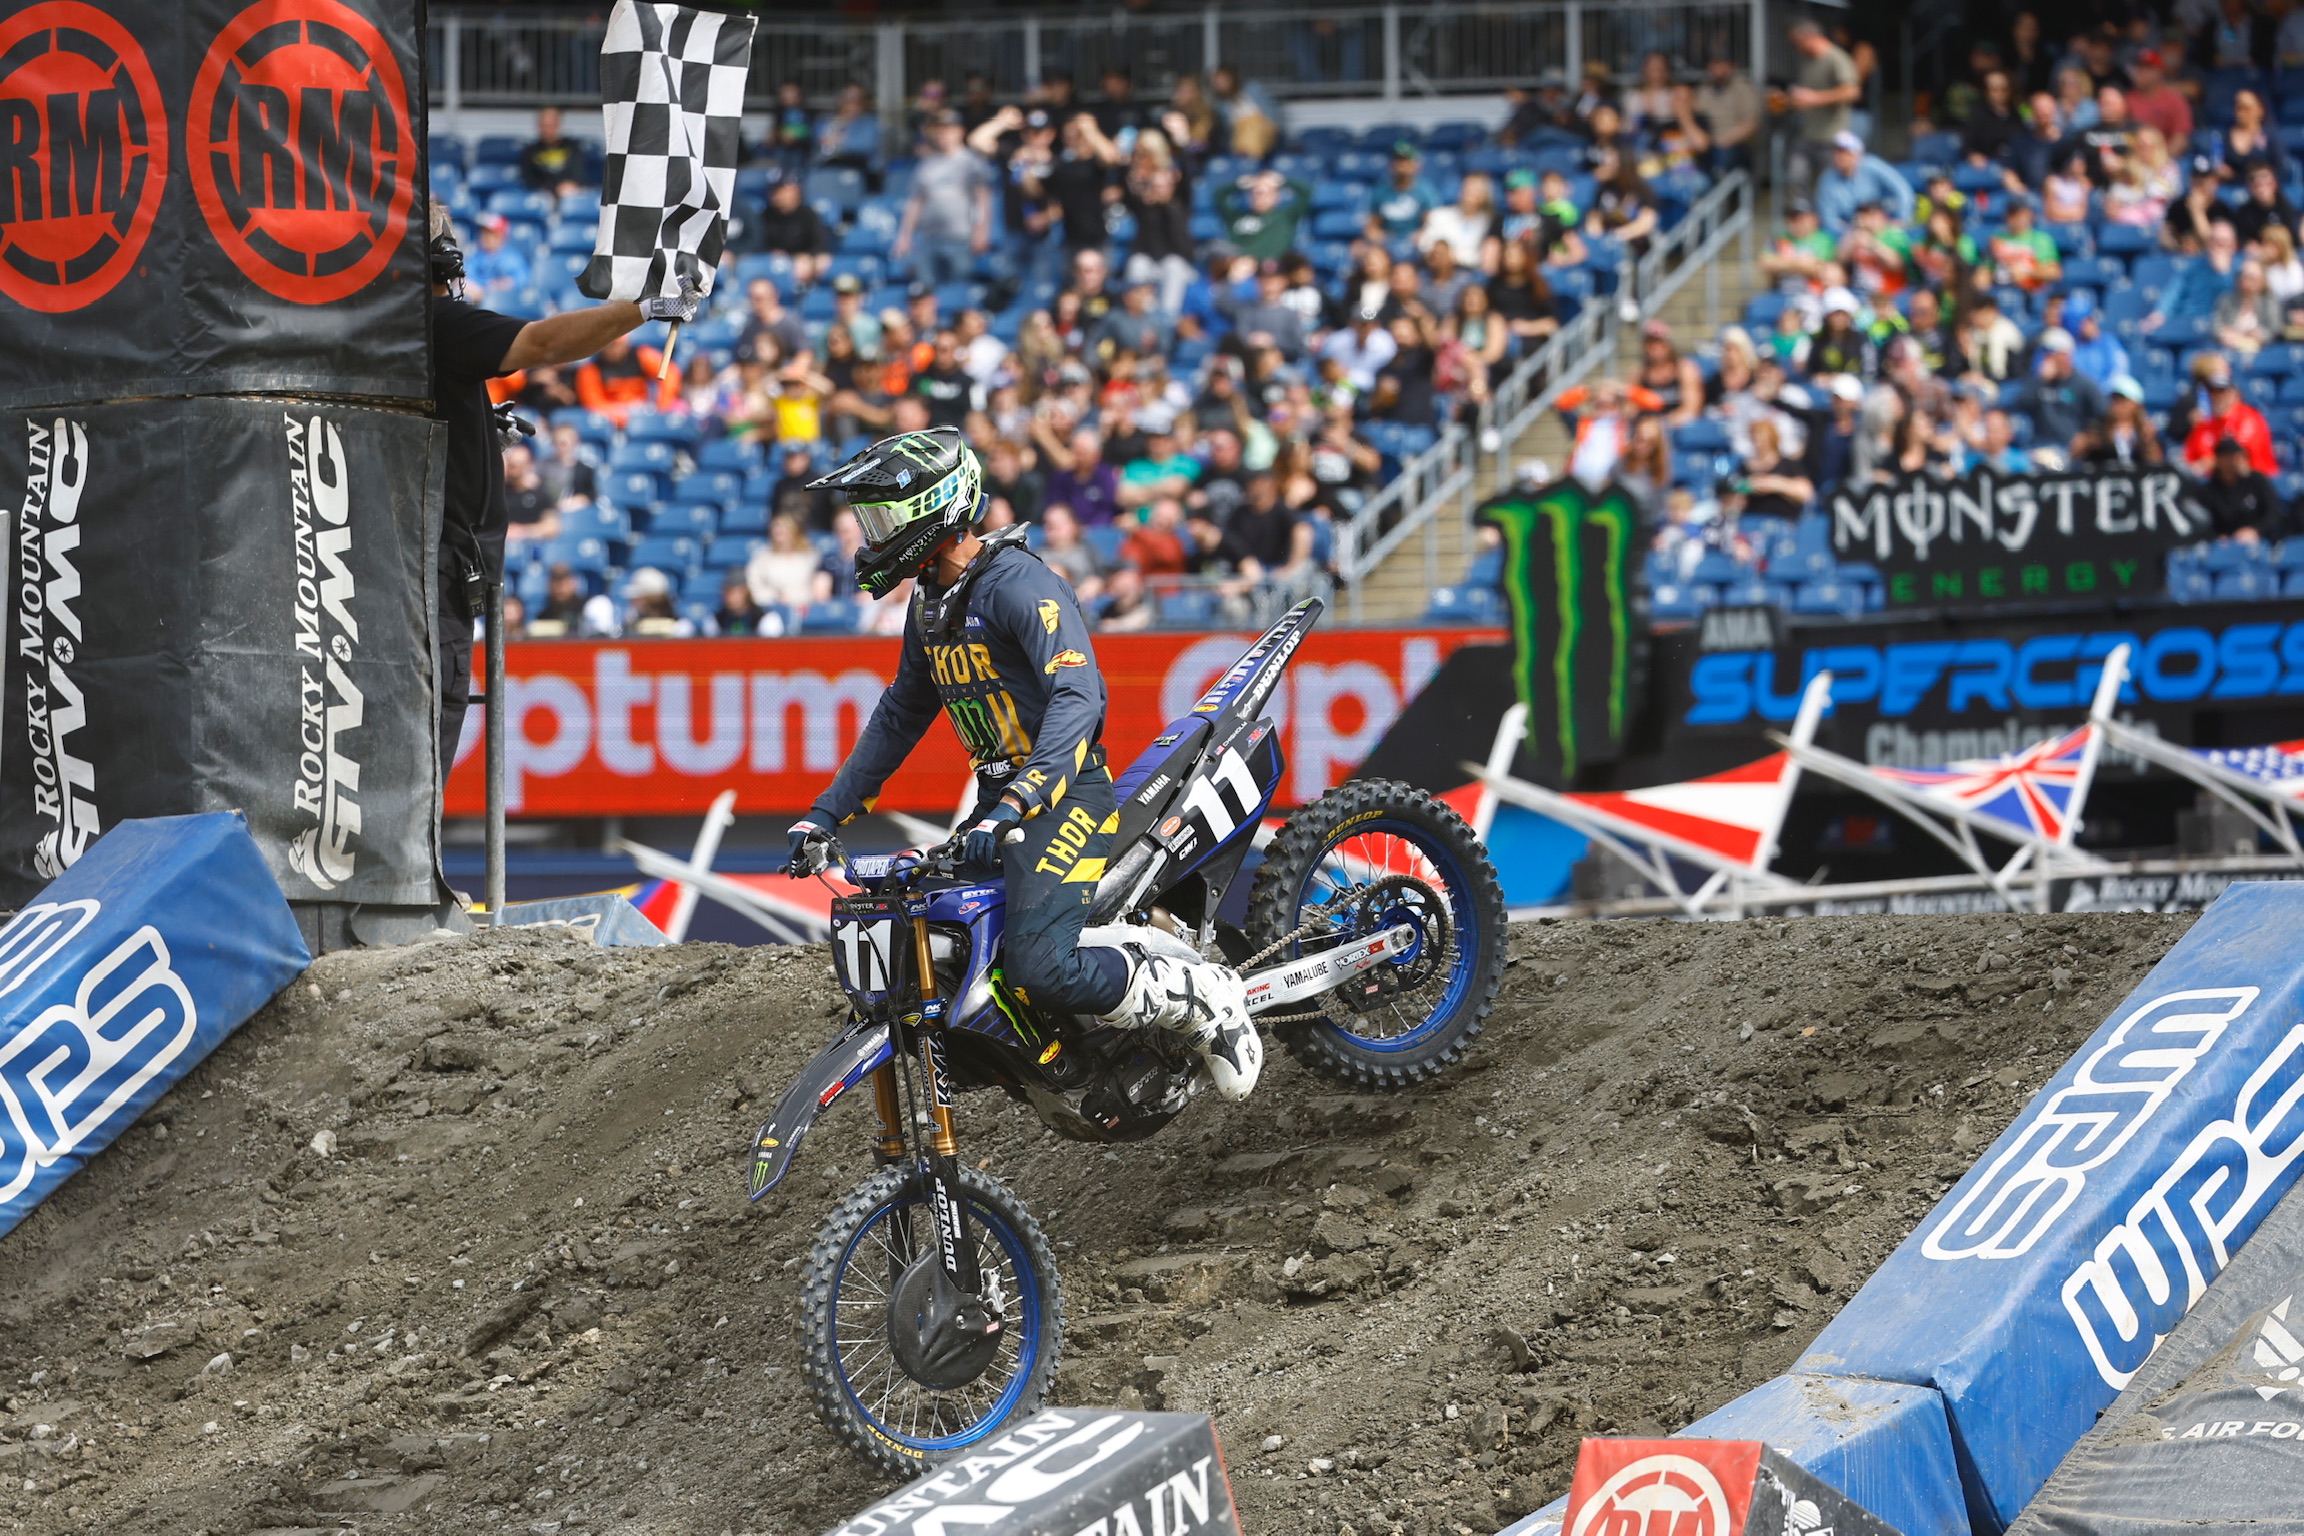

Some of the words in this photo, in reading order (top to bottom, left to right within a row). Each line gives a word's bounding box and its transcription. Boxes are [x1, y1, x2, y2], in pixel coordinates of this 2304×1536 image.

[238, 83, 384, 212] RM
[908, 460, 977, 520] 100%
[1833, 470, 2193, 562] MONSTER
[20, 418, 51, 665] MOUNTAIN
[284, 412, 320, 663] MOUNTAIN
[898, 525, 941, 563] MONSTER
[1891, 558, 2140, 602] ENERGY
[1702, 611, 1773, 648] AMA
[1252, 630, 1301, 701] DUNLOP
[26, 671, 61, 823] ROCKY
[294, 666, 325, 820] ROCKY
[453, 650, 896, 813] ptum
[1222, 721, 1248, 747] CHISHOLM
[1137, 774, 1171, 806] YAMAHA
[1181, 746, 1263, 844] 11
[1035, 806, 1098, 876] THOR
[1327, 810, 1384, 840] DUNLOP
[837, 919, 893, 992] 11
[1283, 961, 1329, 988] YAMALUBE
[1247, 983, 1270, 995] AKING
[1249, 993, 1275, 1007] XCEL
[862, 1033, 883, 1055] YAMAHA
[1128, 1066, 1159, 1097] GYTR
[1922, 985, 2260, 1260] WPS
[935, 1177, 957, 1272] DUNLOP
[950, 1200, 962, 1239] BRAKING
[866, 1424, 924, 1459] DUNLOP
[2179, 1420, 2245, 1440] AIR
